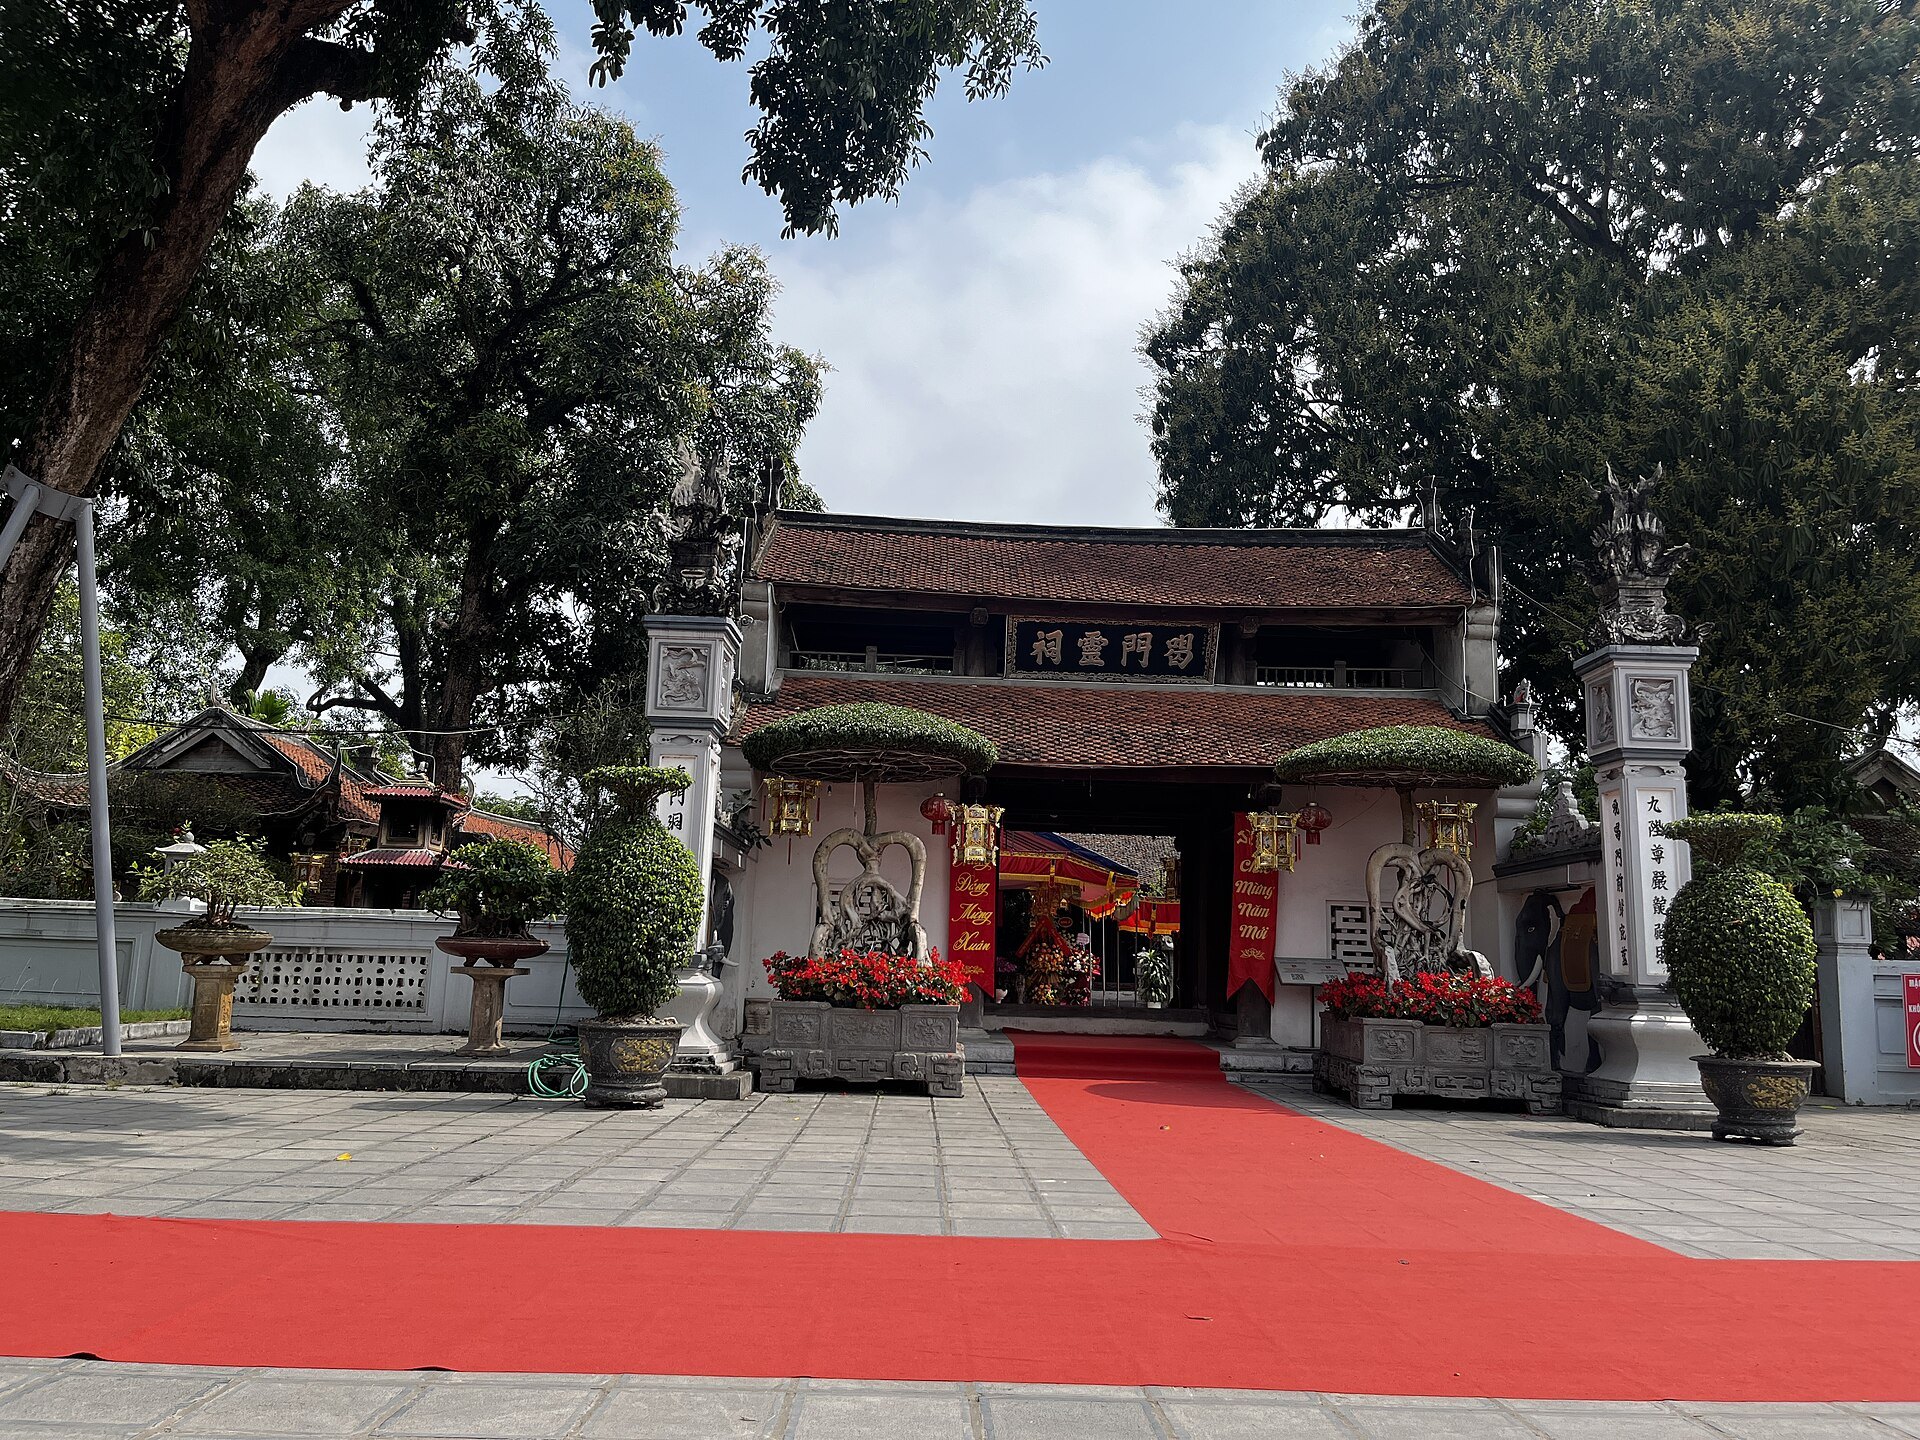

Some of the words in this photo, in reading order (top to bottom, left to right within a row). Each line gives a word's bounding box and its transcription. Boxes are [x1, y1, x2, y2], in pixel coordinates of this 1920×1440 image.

[1234, 880, 1275, 900] Mừng
[1238, 902, 1270, 918] Năm
[1239, 924, 1270, 940] Mới
